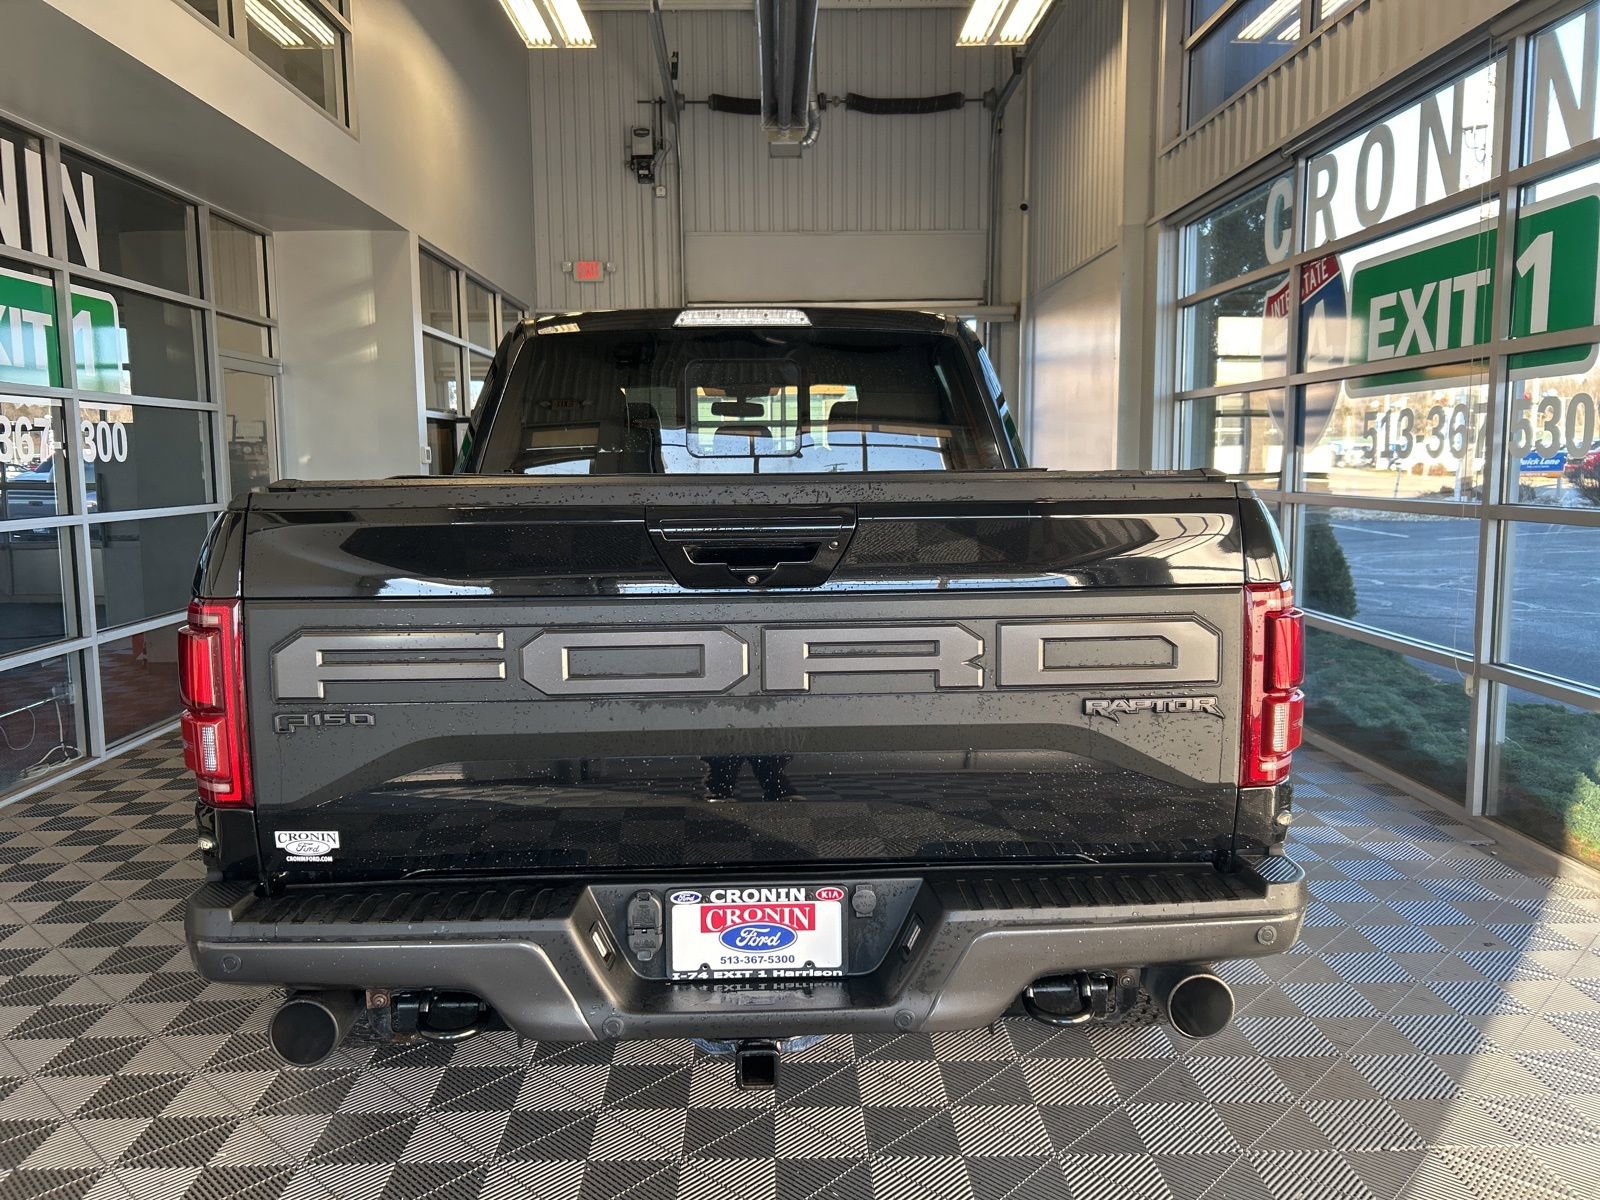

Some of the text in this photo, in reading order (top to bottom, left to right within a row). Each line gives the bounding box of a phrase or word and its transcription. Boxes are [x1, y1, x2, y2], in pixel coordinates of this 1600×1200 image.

[1271, 257, 1328, 318] INTETATE
[1368, 231, 1553, 361] EXIT 1
[72, 309, 96, 377] 1
[271, 618, 1222, 700] FORD
[1083, 697, 1225, 722] RAPTOR
[278, 832, 336, 845] CRONIN
[296, 843, 320, 852] Ford
[710, 888, 805, 903] CRONIN
[821, 891, 839, 899] KIA
[706, 907, 810, 931] CRONIN
[736, 927, 781, 946] Ford
[720, 955, 795, 964] 513-367-5300
[672, 969, 842, 980] I-74 EXIT 1 Harrison
